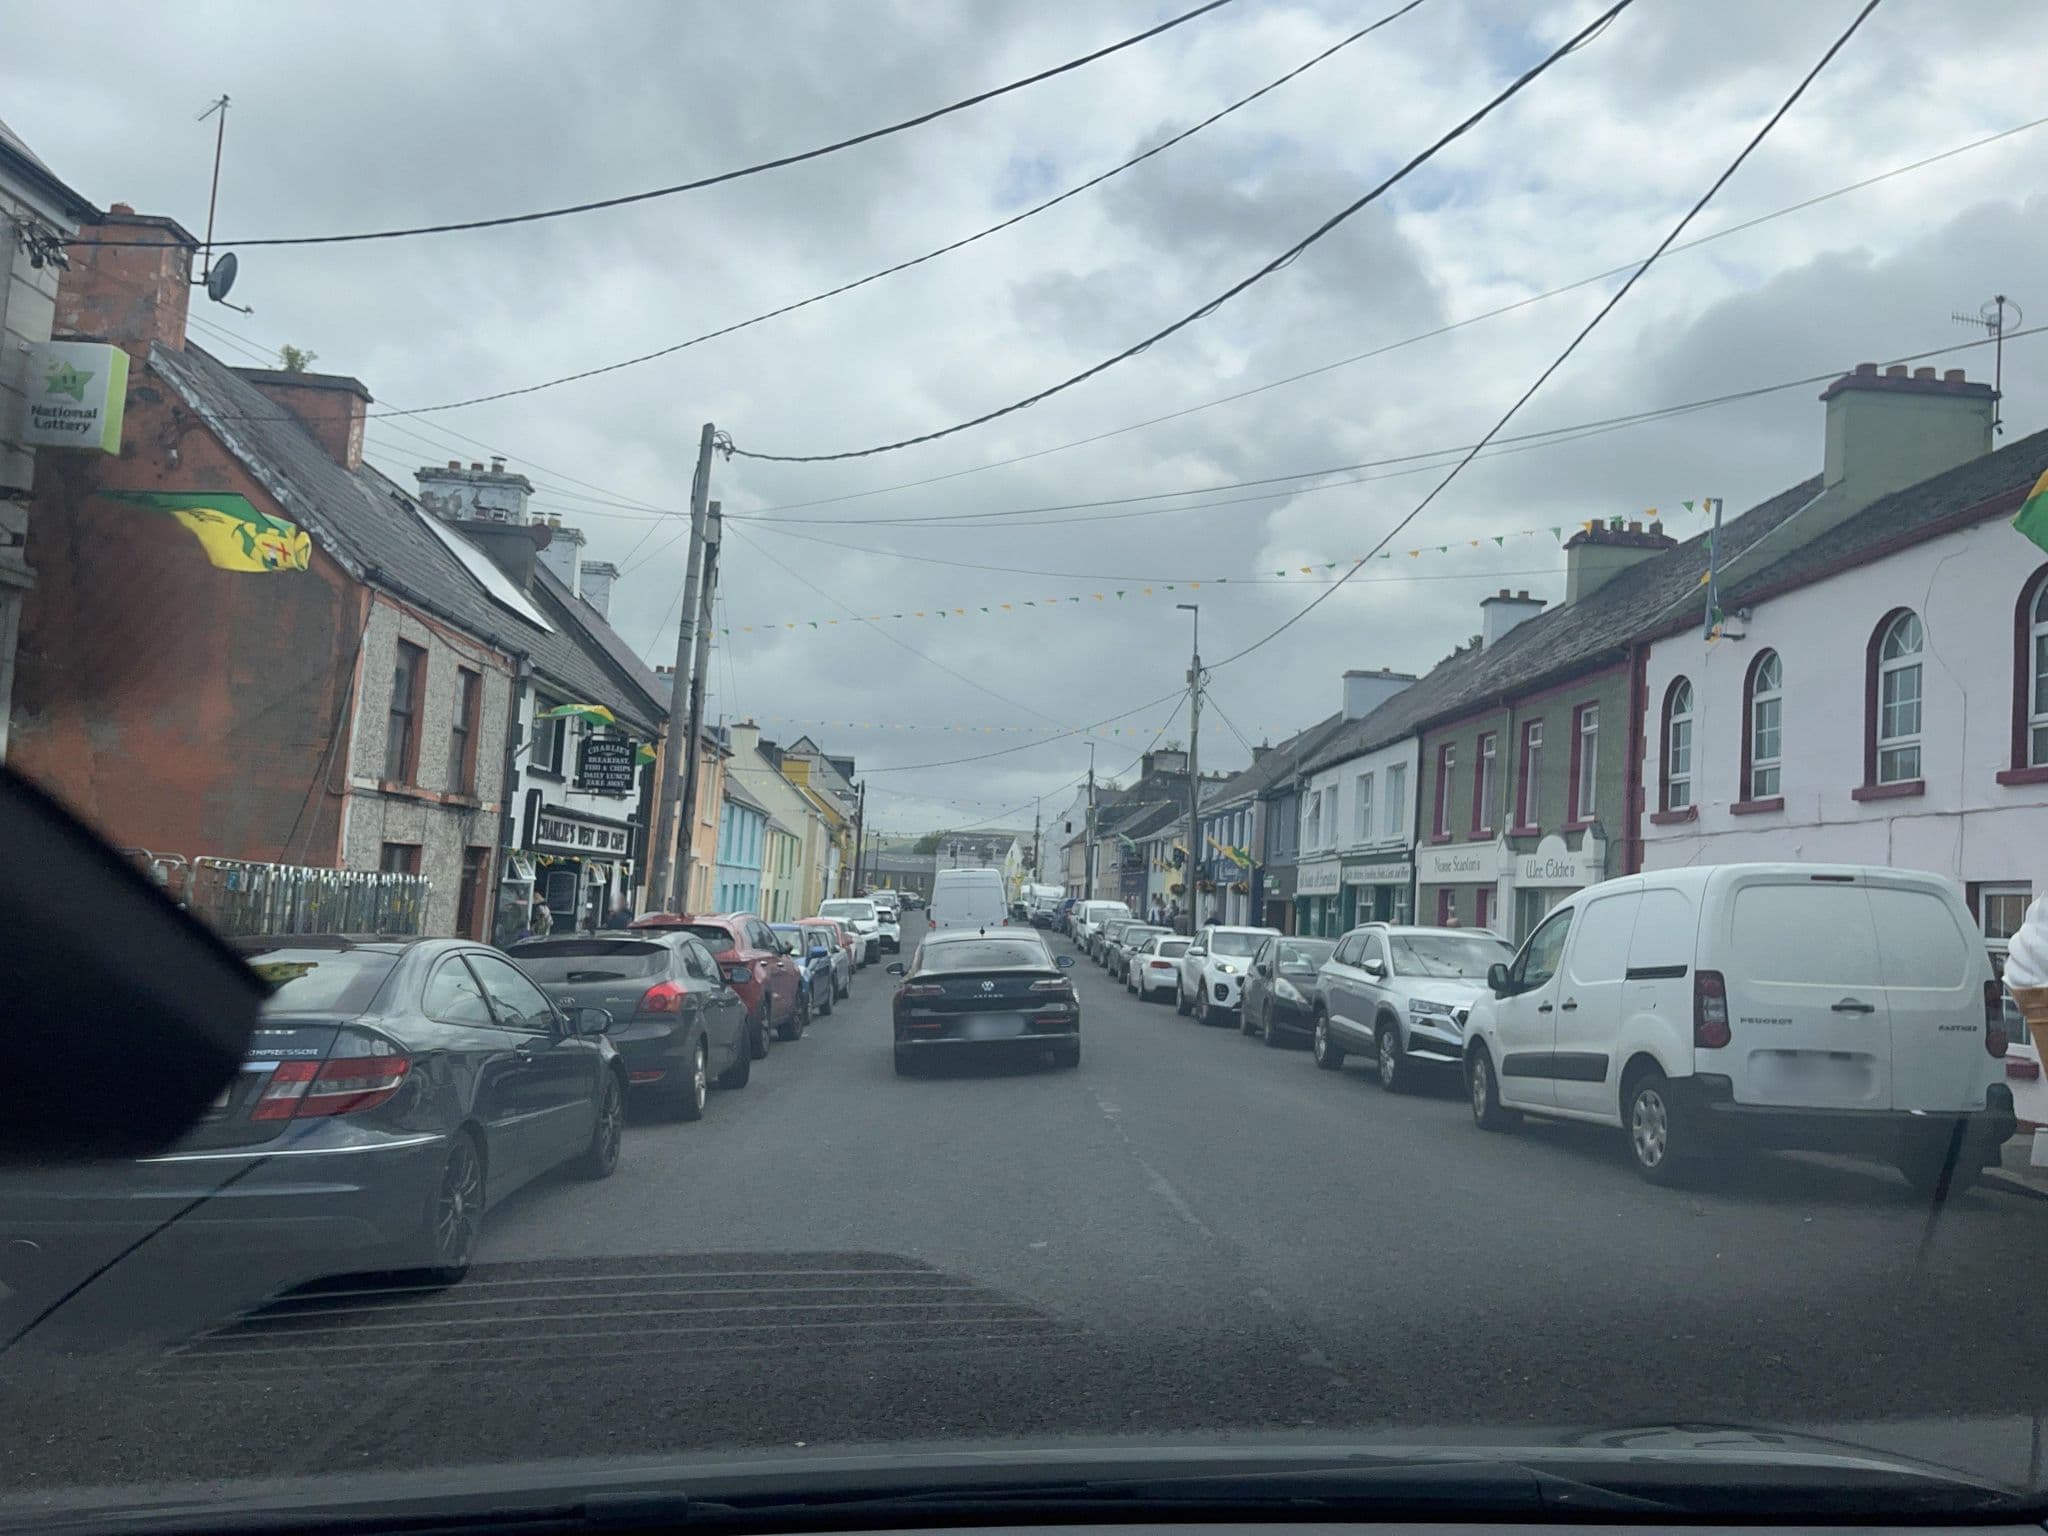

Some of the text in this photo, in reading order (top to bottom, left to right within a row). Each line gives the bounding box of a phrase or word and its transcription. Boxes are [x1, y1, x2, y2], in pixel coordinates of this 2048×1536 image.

[31, 404, 98, 418] National
[33, 416, 91, 434] Lottery
[1740, 1017, 1793, 1025] PEUGEOT
[248, 1048, 319, 1056] OMPRESSOR
